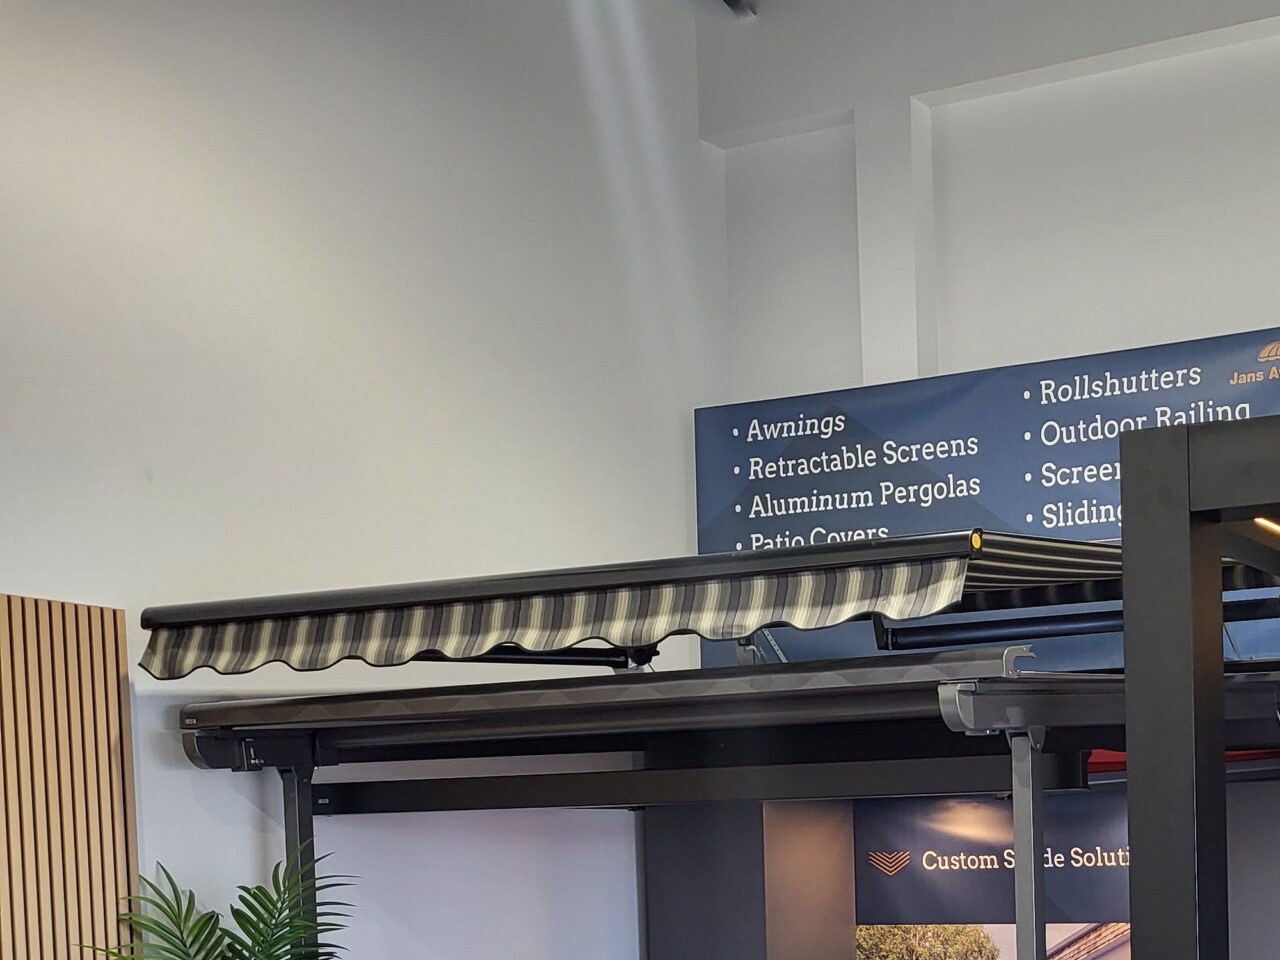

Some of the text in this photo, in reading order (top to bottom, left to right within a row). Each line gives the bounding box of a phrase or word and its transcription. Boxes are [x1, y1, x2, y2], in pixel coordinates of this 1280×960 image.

[1040, 366, 1201, 405] Rollshutters
[1229, 372, 1264, 386] Jans
[746, 413, 846, 442] Awnings
[1040, 414, 1148, 446] Outdoor
[748, 437, 979, 480] Retractable Screens
[748, 474, 981, 518] Aluminum Pergolas
[1042, 499, 1122, 528] Slidin
[750, 527, 889, 550] Patio Covers
[922, 846, 1130, 871] Custom Sde Soluti
